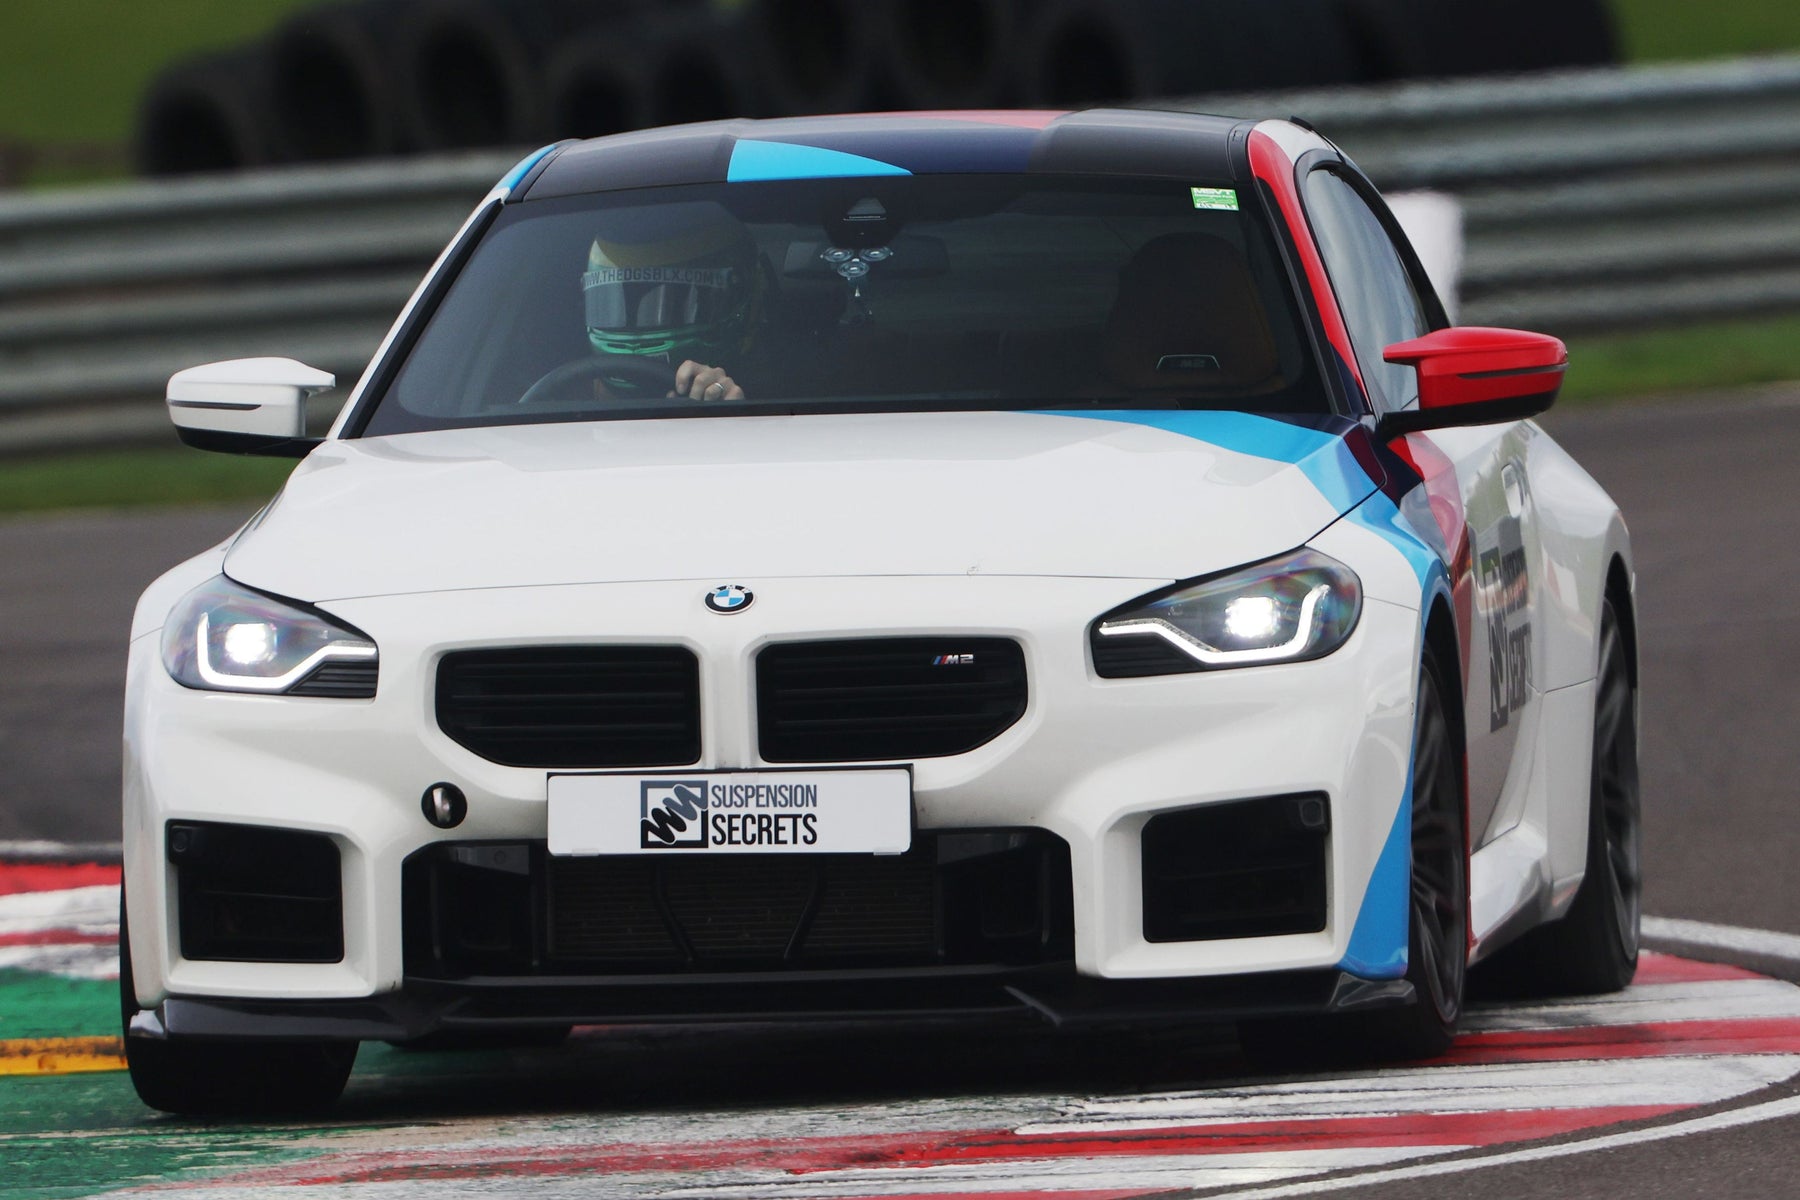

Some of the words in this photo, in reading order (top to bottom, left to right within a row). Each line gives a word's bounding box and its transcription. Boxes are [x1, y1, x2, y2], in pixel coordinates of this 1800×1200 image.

[941, 653, 974, 665] M2
[711, 784, 818, 808] SUSPENSION
[711, 813, 818, 846] SECRETS
